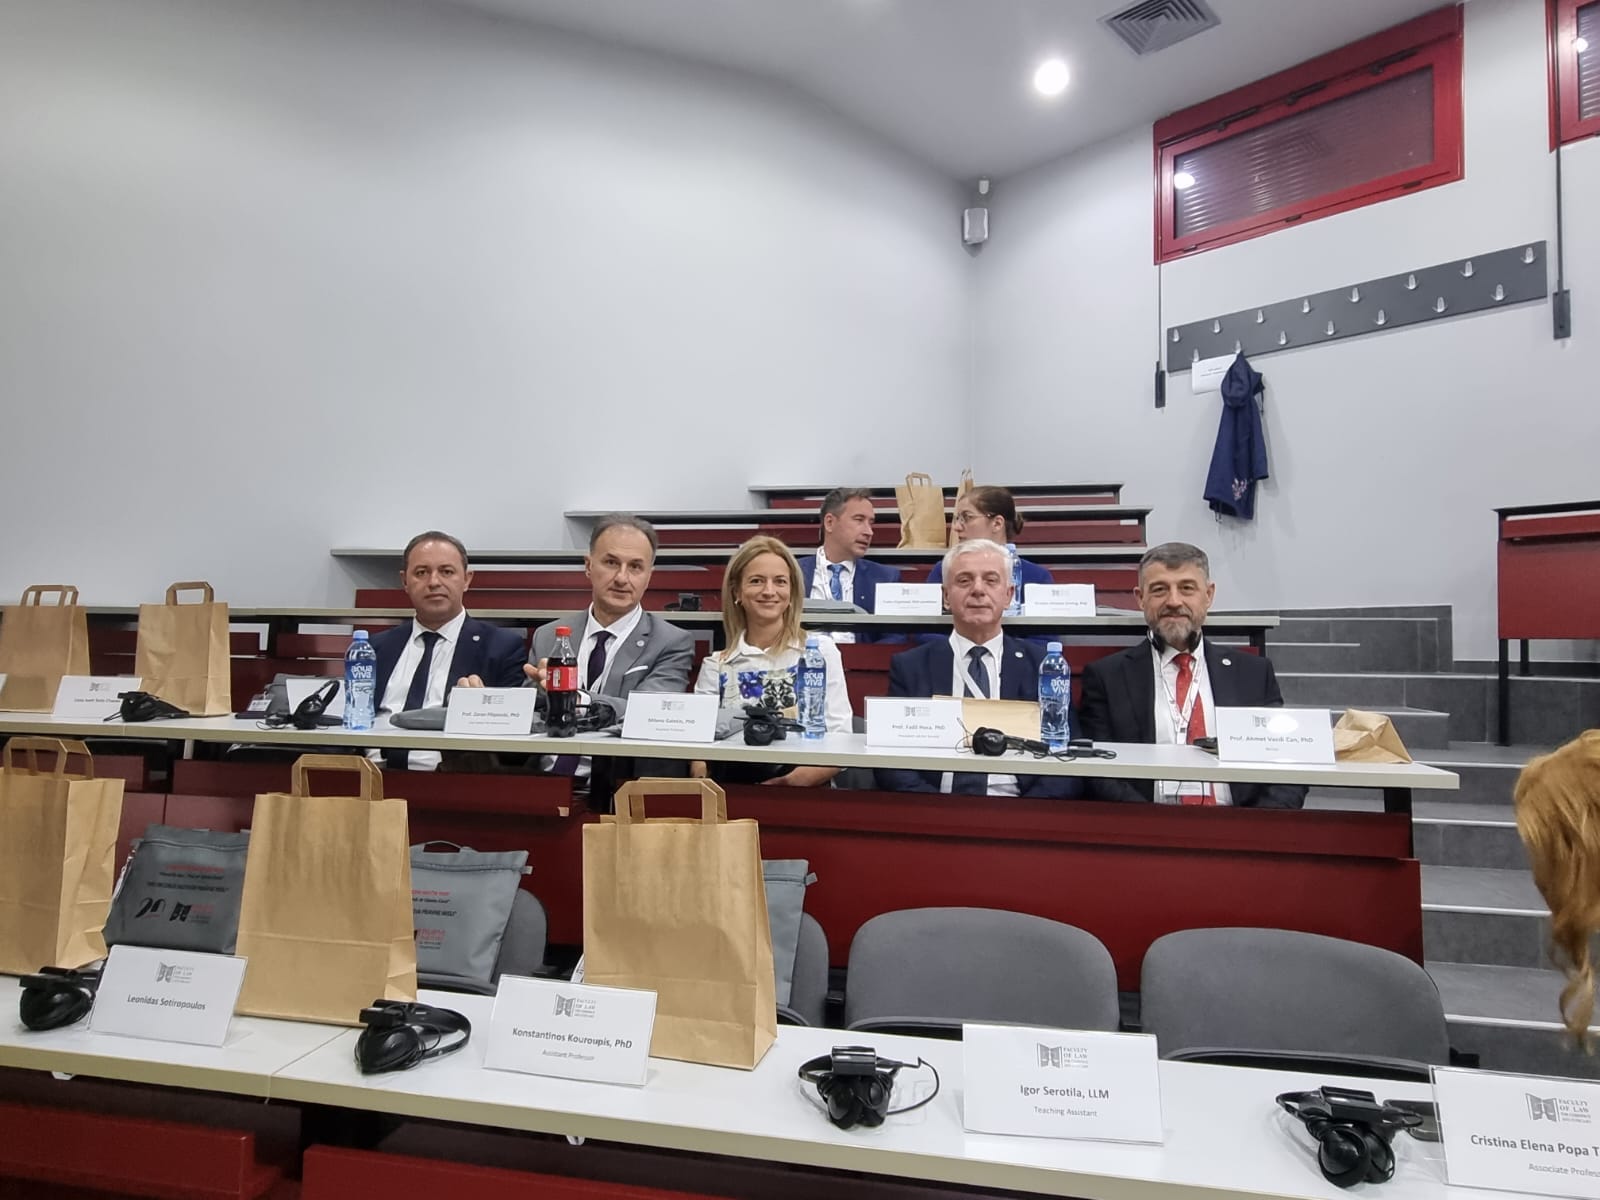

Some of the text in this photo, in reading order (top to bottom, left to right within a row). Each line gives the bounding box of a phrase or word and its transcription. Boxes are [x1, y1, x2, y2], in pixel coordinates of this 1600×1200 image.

[127, 994, 206, 1010] Leonidas Sotiropoulos
[512, 1027, 633, 1049] Konstantinos Kouroupis, PhD
[1020, 1084, 1109, 1099] Igor Serotila, LLM
[1034, 1106, 1098, 1117] Teaching Assistant
[1470, 1134, 1518, 1149] Cristina
[1520, 1139, 1555, 1153] Elena
[1557, 1143, 1590, 1157] Popa
[1528, 1163, 1569, 1174] Associate
